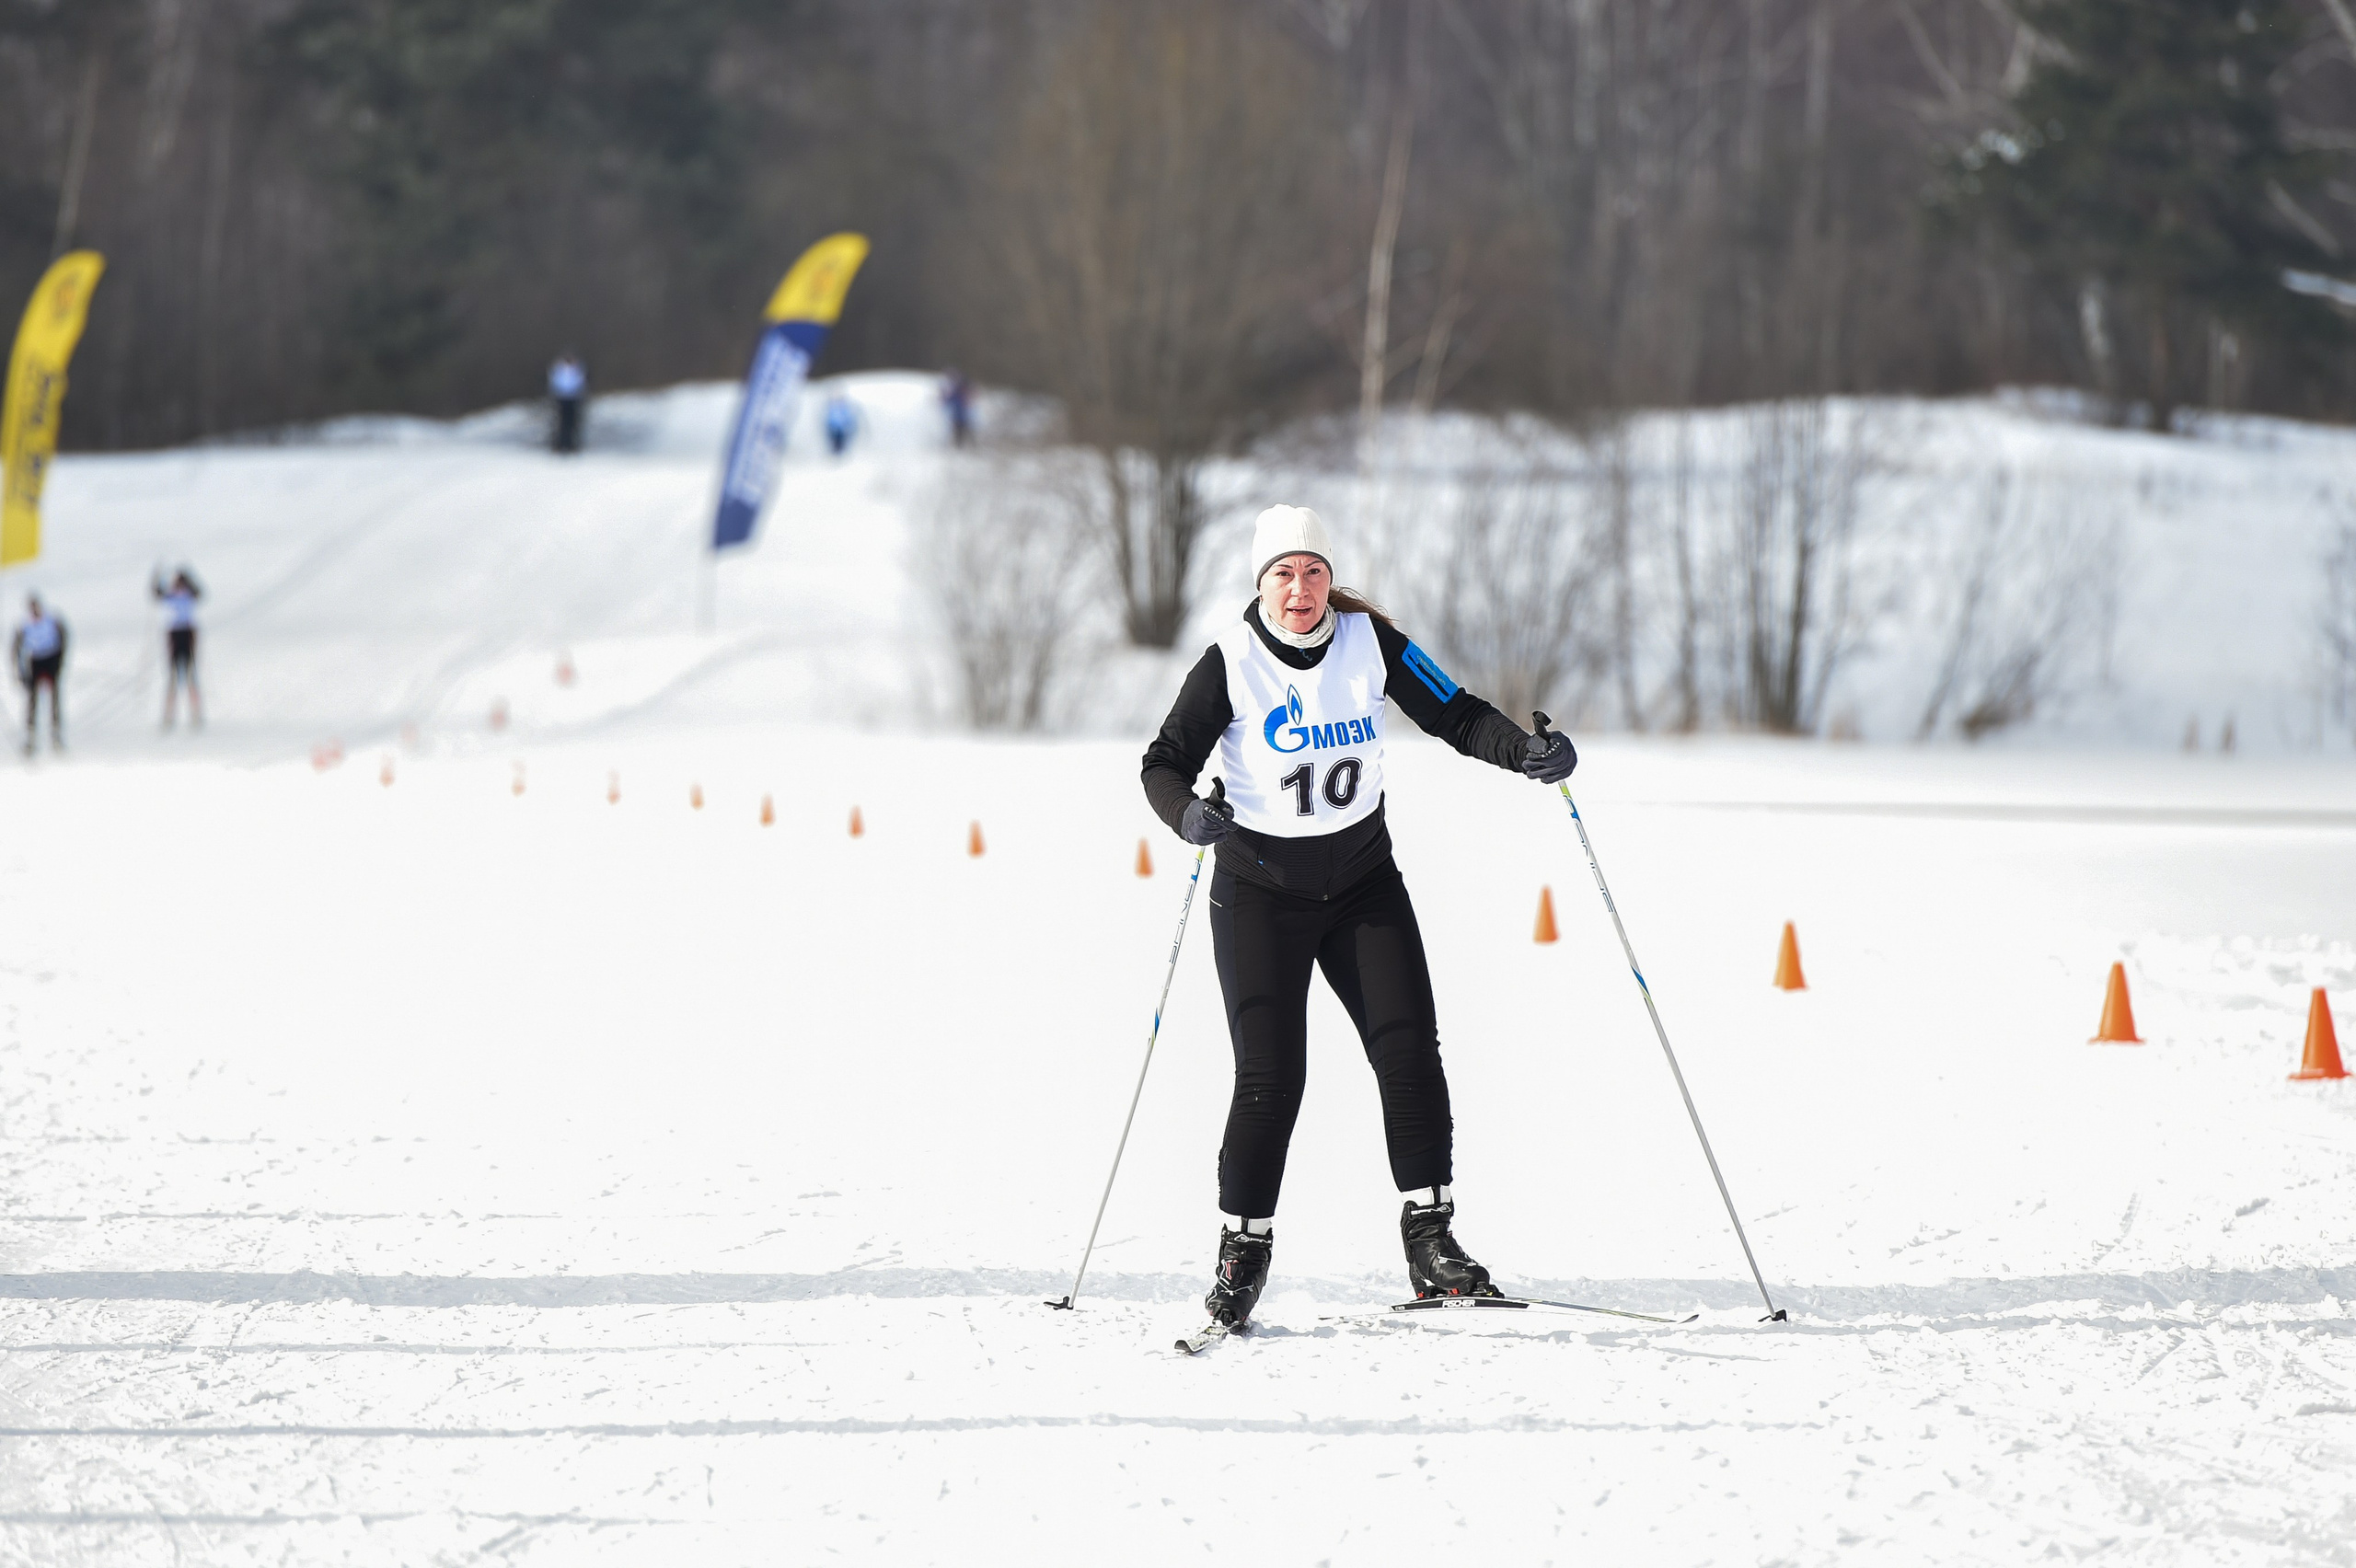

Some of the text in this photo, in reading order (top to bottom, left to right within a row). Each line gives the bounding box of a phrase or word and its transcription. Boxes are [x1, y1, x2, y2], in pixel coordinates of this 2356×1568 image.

[1541, 742, 1560, 758] KIPSTA
[1280, 756, 1363, 817] 10
[1204, 806, 1224, 822] KIPSTA
[1441, 1298, 1476, 1309] FISCHER
